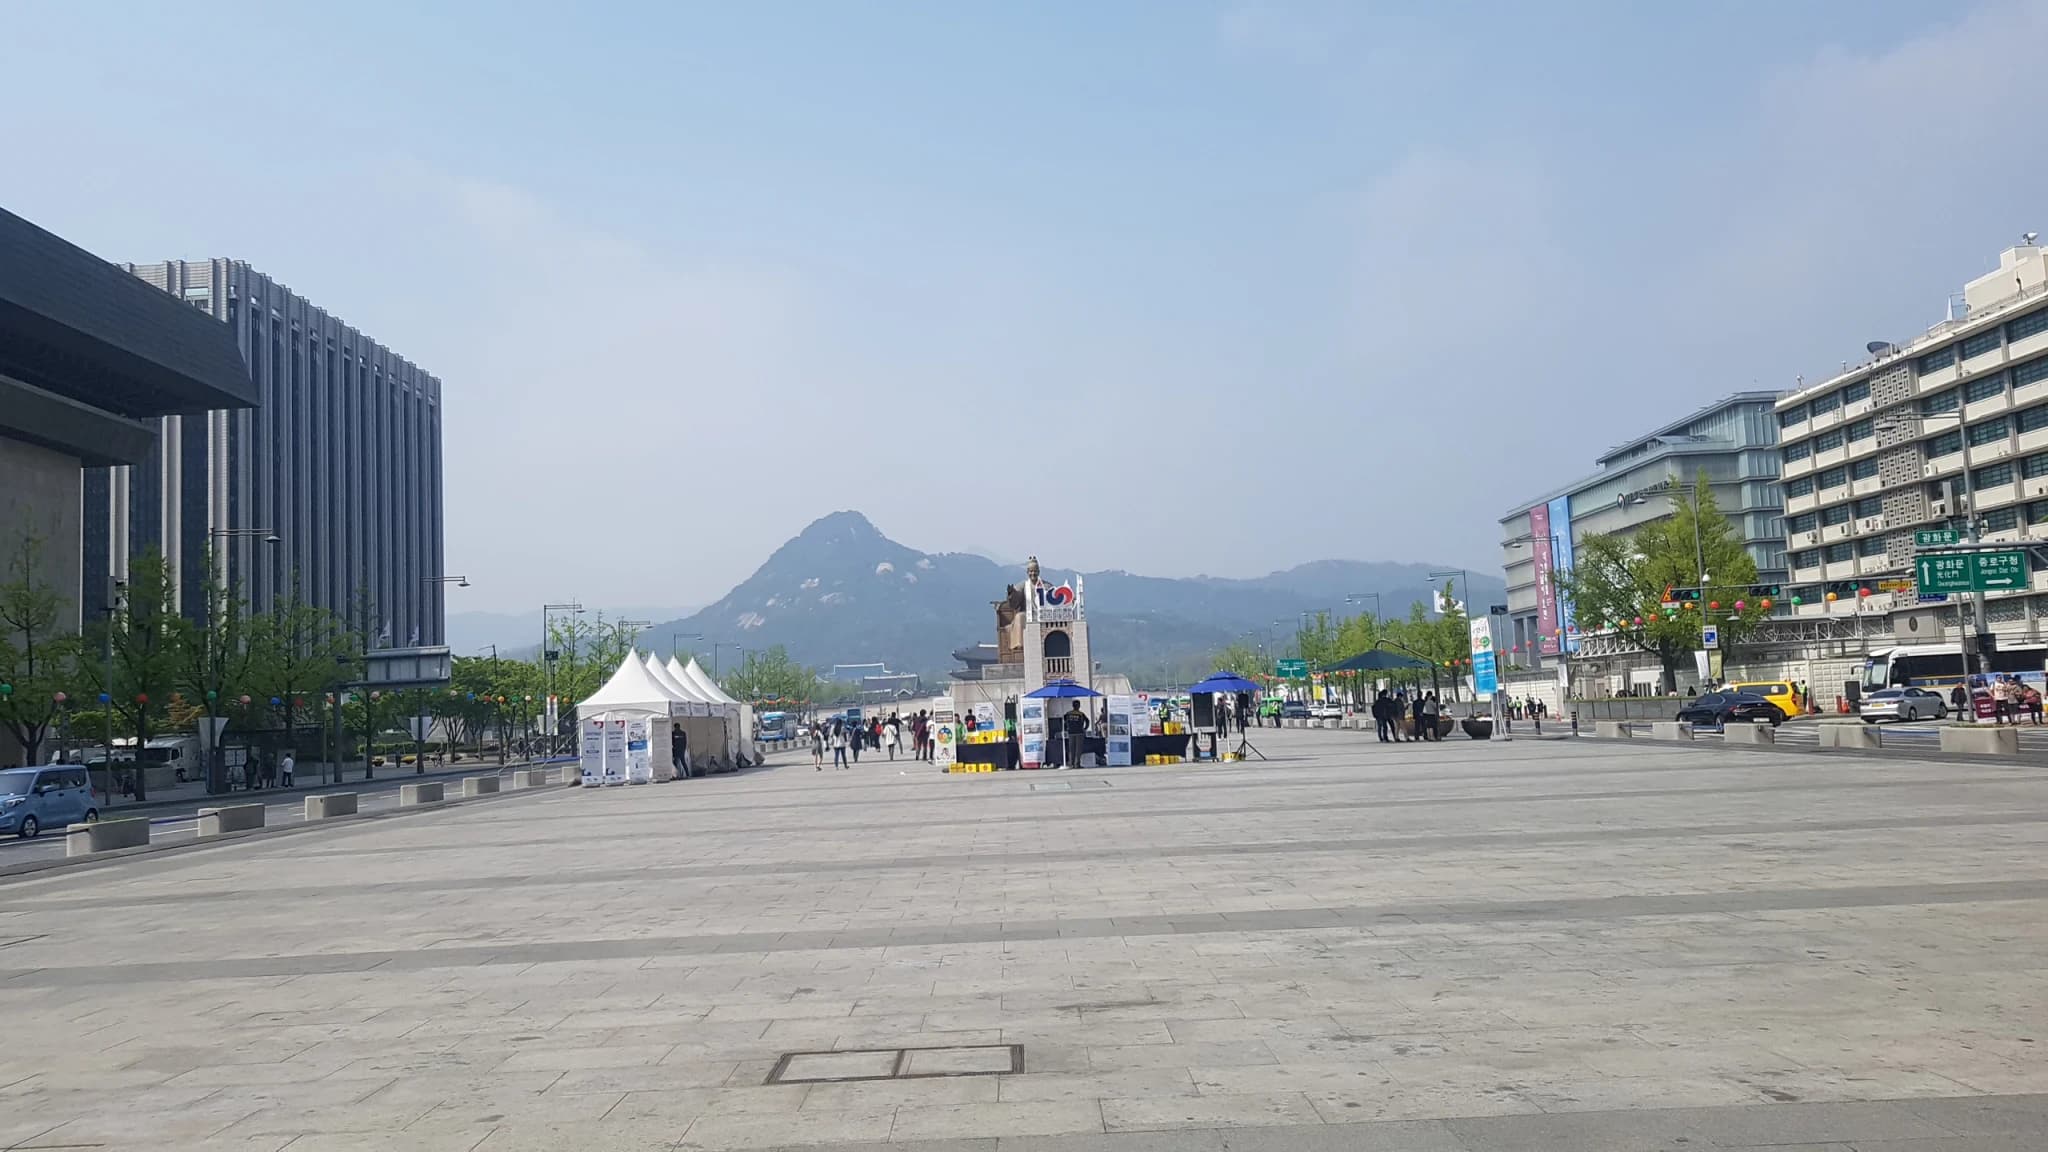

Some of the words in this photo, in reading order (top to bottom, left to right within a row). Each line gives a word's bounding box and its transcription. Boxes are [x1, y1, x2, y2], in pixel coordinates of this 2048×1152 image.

[1922, 532, 1953, 543] 광화문
[1936, 559, 1965, 570] 광화문
[1979, 556, 2018, 567] 종로구청
